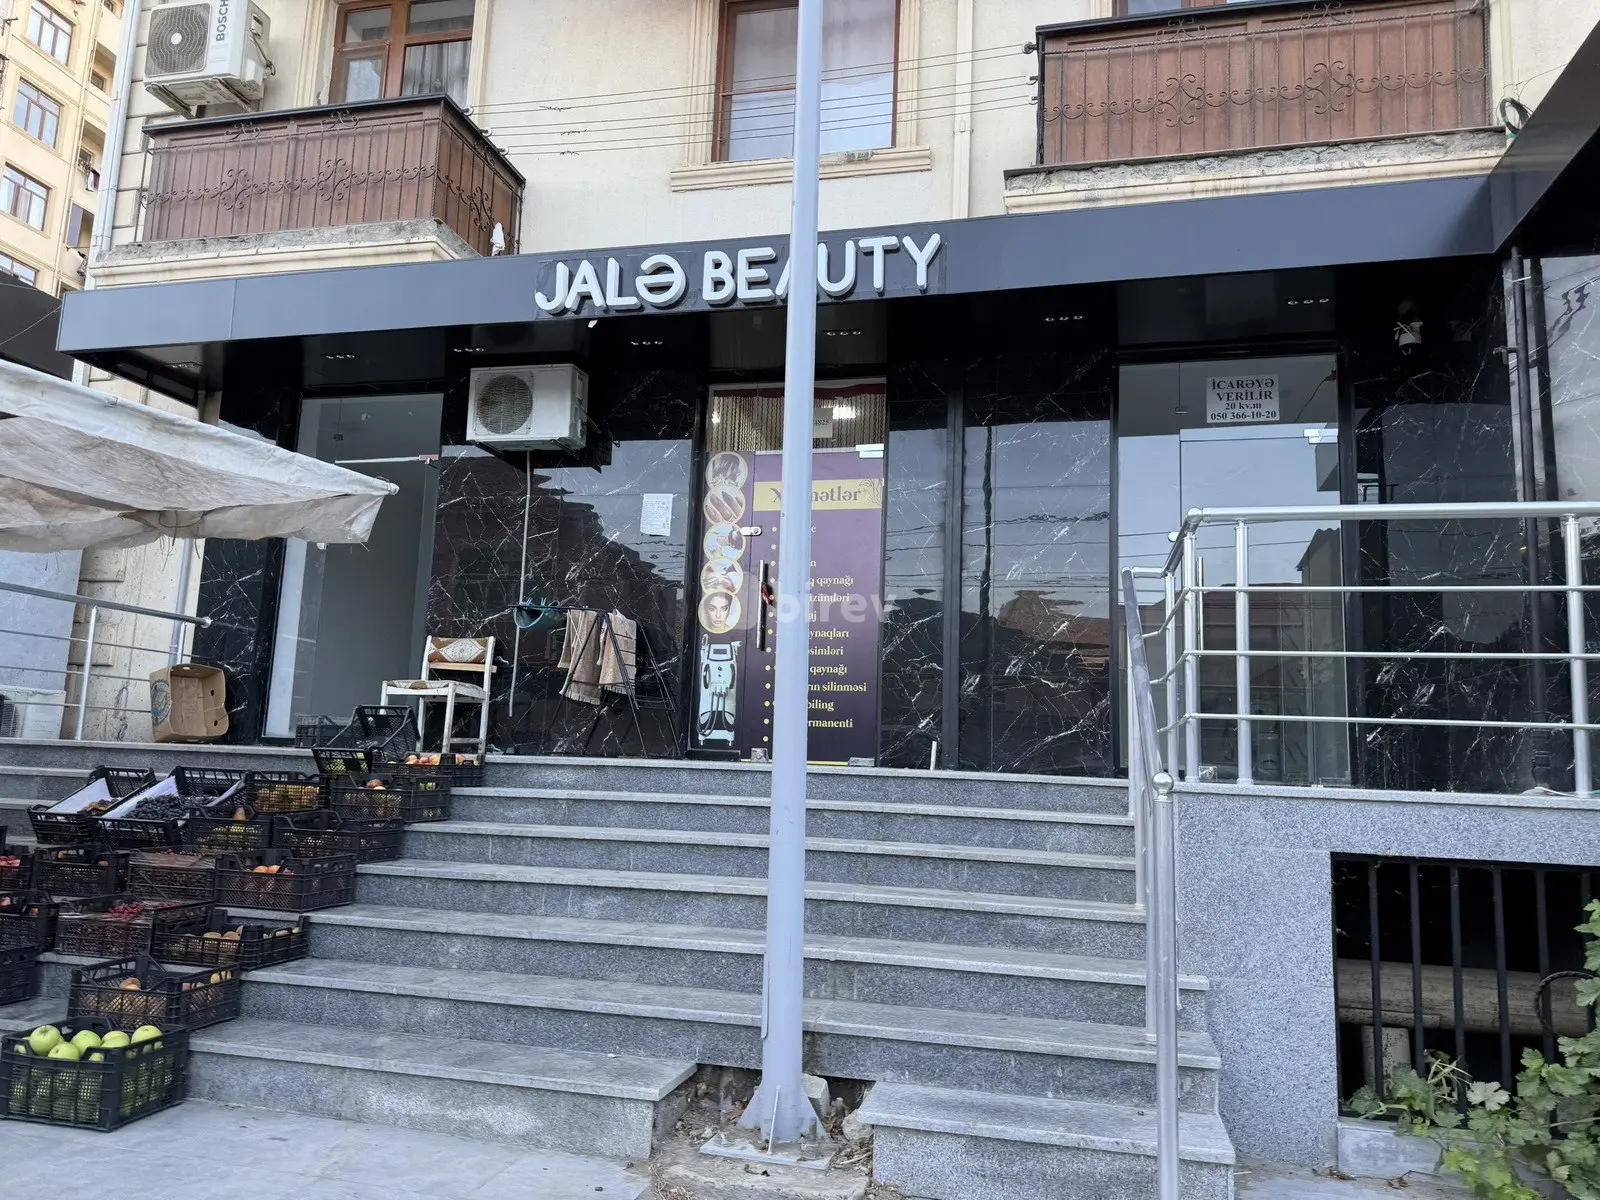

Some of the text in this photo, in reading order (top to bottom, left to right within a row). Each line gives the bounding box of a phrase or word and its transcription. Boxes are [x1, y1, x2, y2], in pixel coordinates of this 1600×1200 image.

[215, 0, 229, 42] BOSCH
[534, 253, 688, 315] JALƏ
[1212, 378, 1275, 390] İCARƏYƏ
[1216, 389, 1273, 401] VERİLİR
[1225, 402, 1262, 410] 20 kv.m
[1210, 410, 1277, 421] 050 366-10-20
[769, 485, 861, 503] Xətlər
[816, 575, 854, 587] qaynağı
[808, 628, 849, 639] ynaqları
[808, 646, 844, 655] simləri
[809, 664, 848, 675] qaynağı
[822, 681, 867, 692] silinməsi
[807, 718, 854, 728] rmanenti
